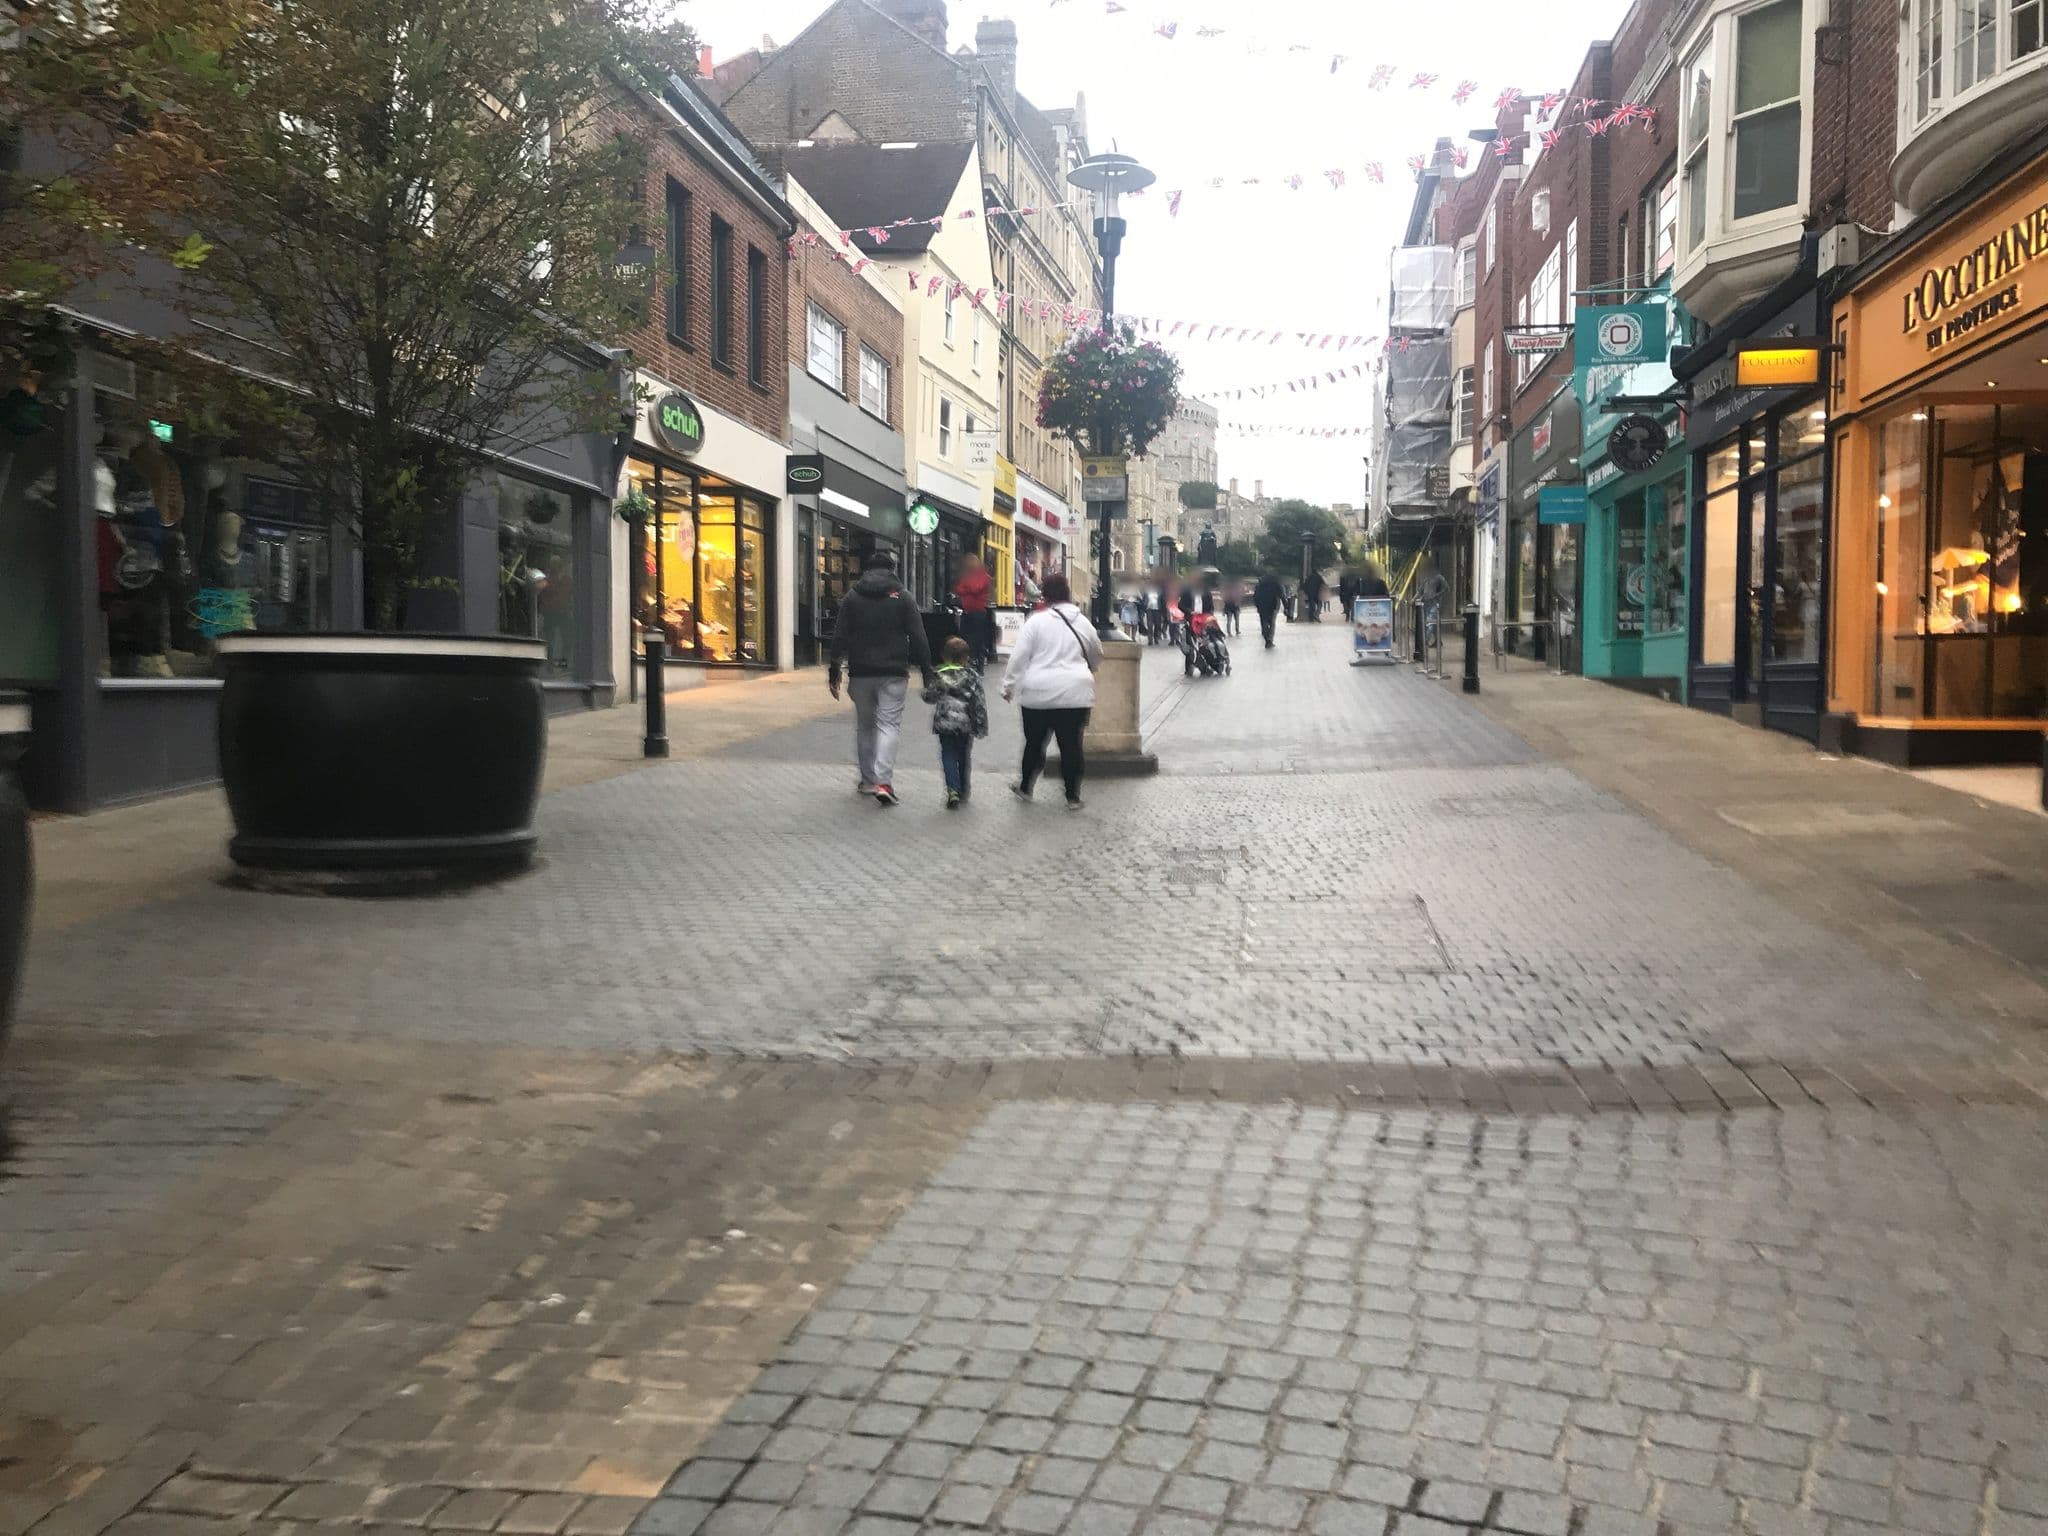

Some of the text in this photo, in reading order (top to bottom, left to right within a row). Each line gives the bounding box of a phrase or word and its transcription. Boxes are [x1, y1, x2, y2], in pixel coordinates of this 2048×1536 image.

[1903, 203, 2048, 335] L'OCCITANE
[1602, 316, 1618, 338] PHONE
[1946, 284, 2018, 341] PROVENCE
[663, 405, 699, 440] schuh
[794, 470, 817, 478] schuh
